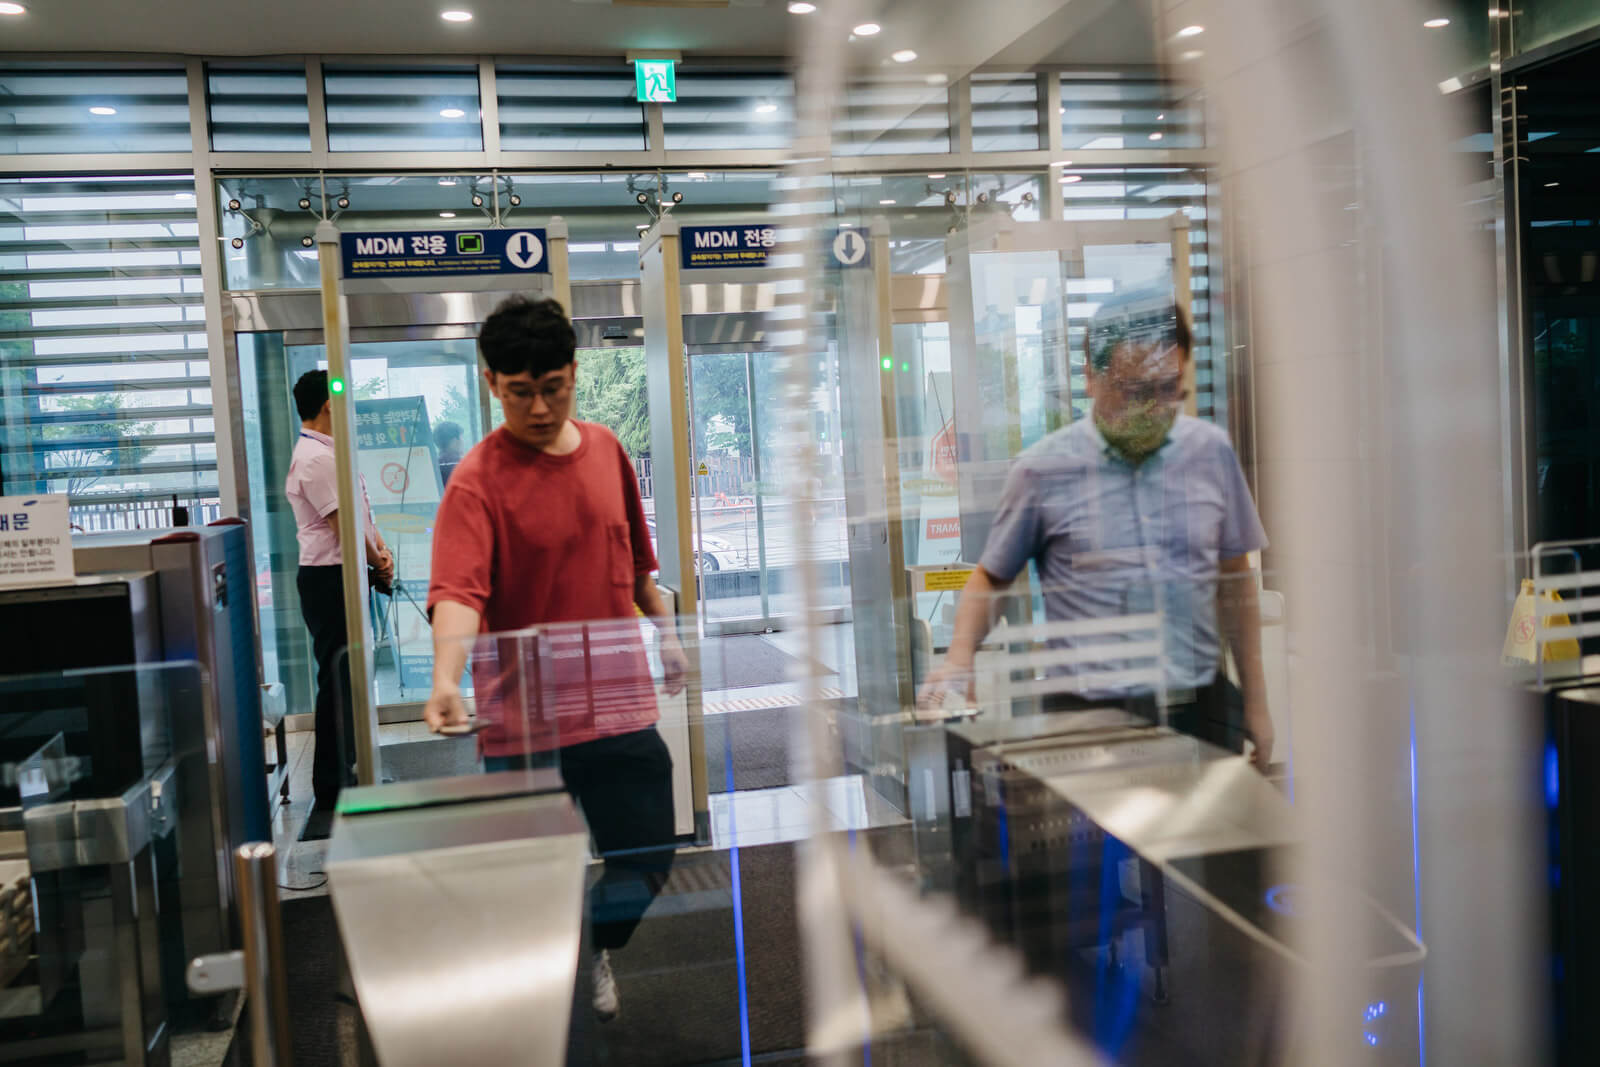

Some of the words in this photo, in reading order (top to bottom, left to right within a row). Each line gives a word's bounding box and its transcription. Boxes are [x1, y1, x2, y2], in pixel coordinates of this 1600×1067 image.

[356, 238, 404, 255] MDM
[411, 235, 447, 254] 전용
[694, 231, 738, 248] MDM
[743, 229, 777, 247] 전용
